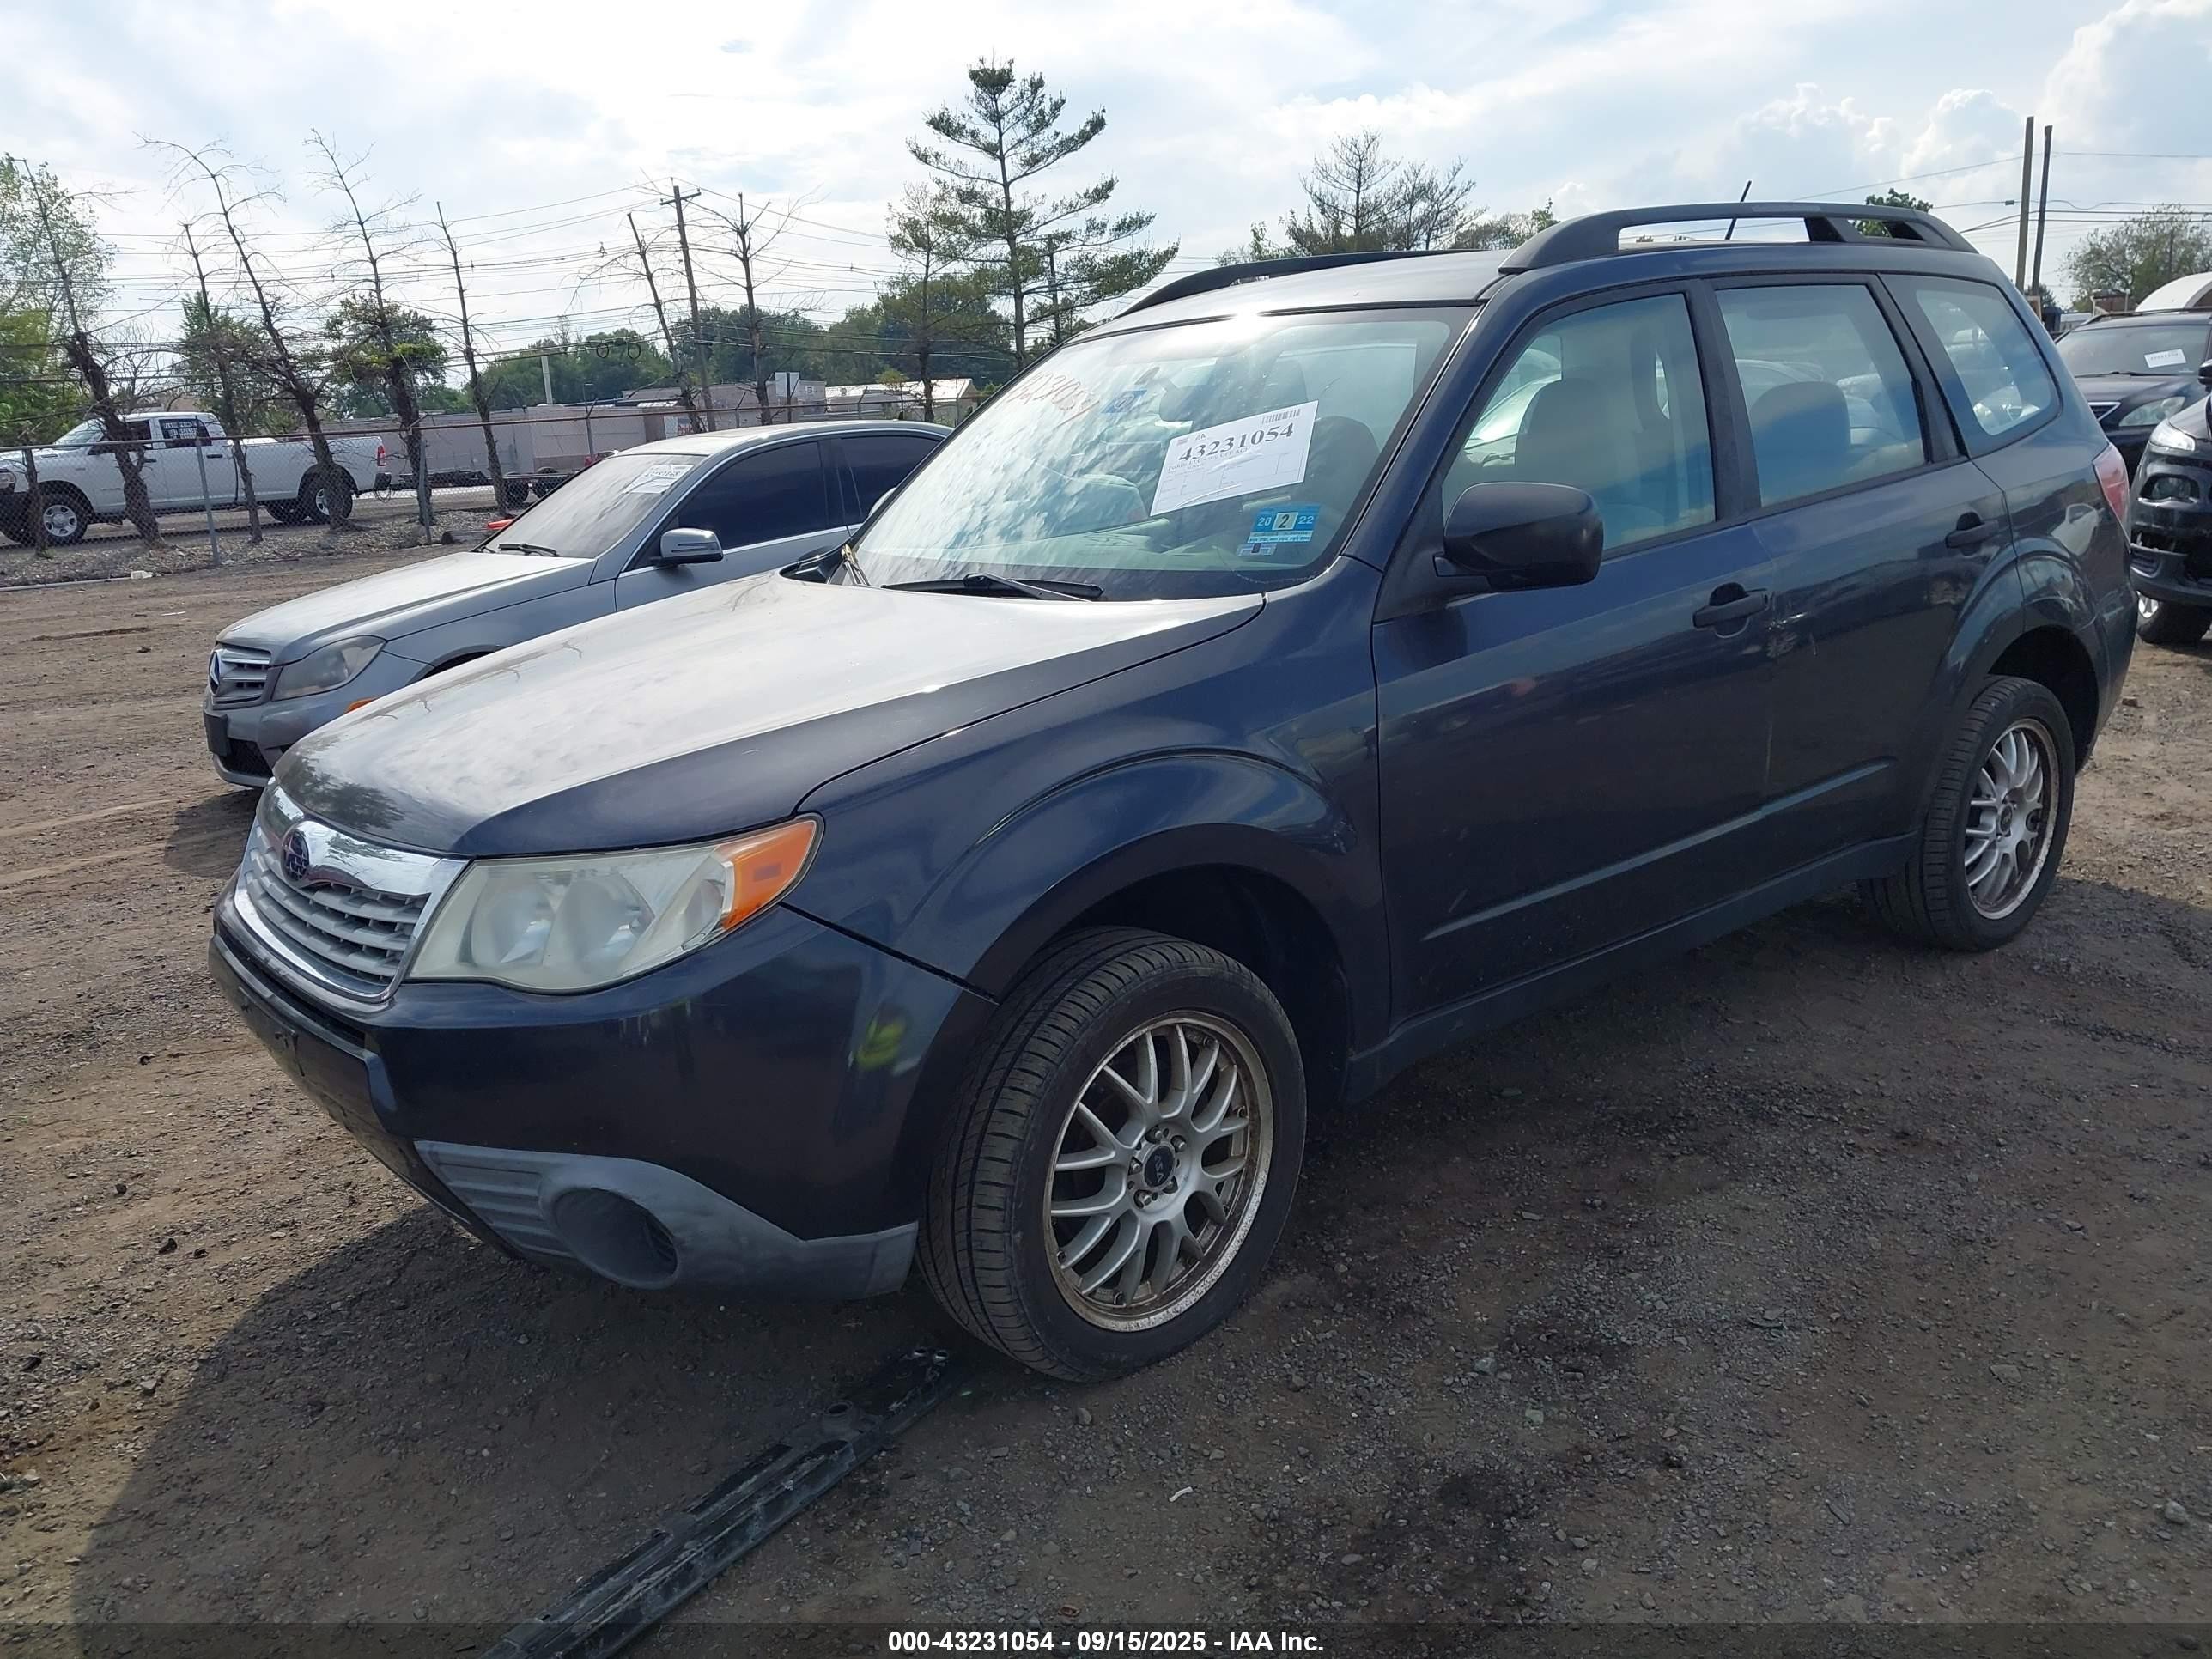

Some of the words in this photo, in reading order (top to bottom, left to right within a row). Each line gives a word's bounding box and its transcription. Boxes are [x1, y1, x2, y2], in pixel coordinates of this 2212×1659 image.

[1178, 422, 1294, 462] 43231054
[1257, 516, 1272, 526] 20
[1278, 514, 1290, 528] 2
[1297, 515, 1314, 525] 22
